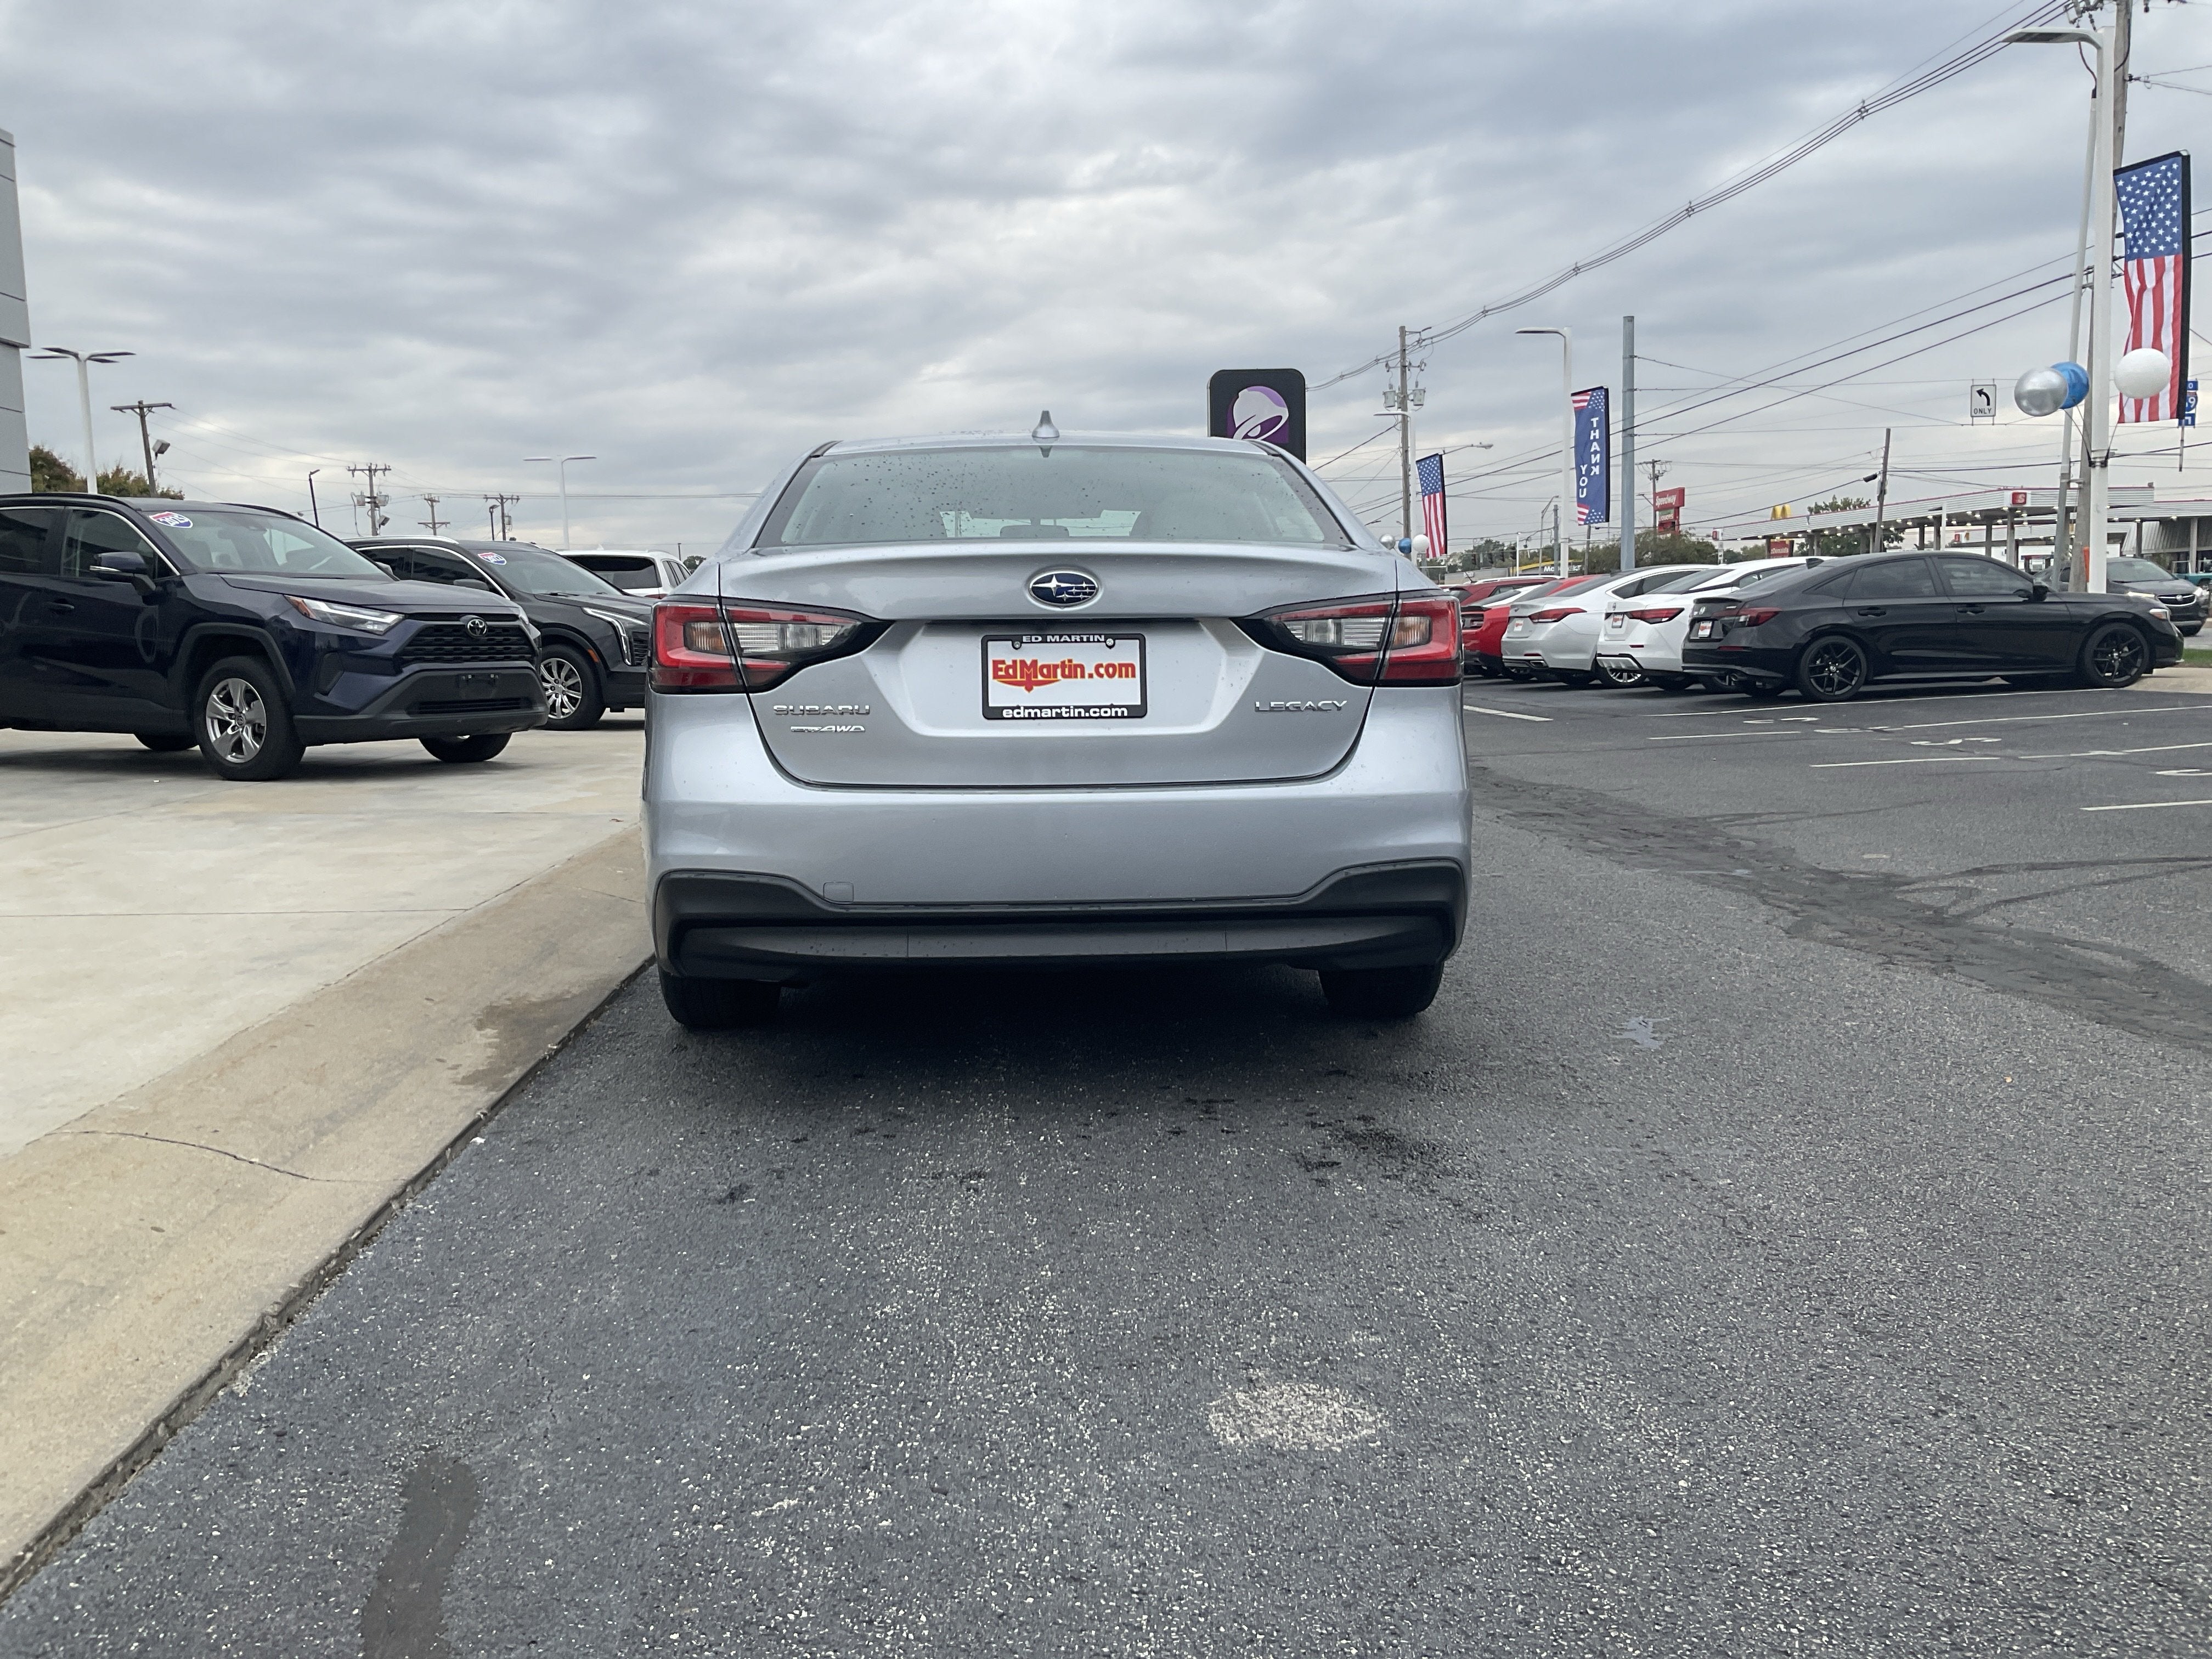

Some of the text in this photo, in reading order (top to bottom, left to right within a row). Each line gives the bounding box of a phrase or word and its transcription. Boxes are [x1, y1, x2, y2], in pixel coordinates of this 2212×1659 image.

[1656, 494, 1677, 508] Speedway
[991, 658, 1137, 680] EdMartin.com
[773, 705, 871, 715] SUBARU
[1002, 706, 1128, 718] edmartin.com
[1255, 700, 1347, 712] LEGACY
